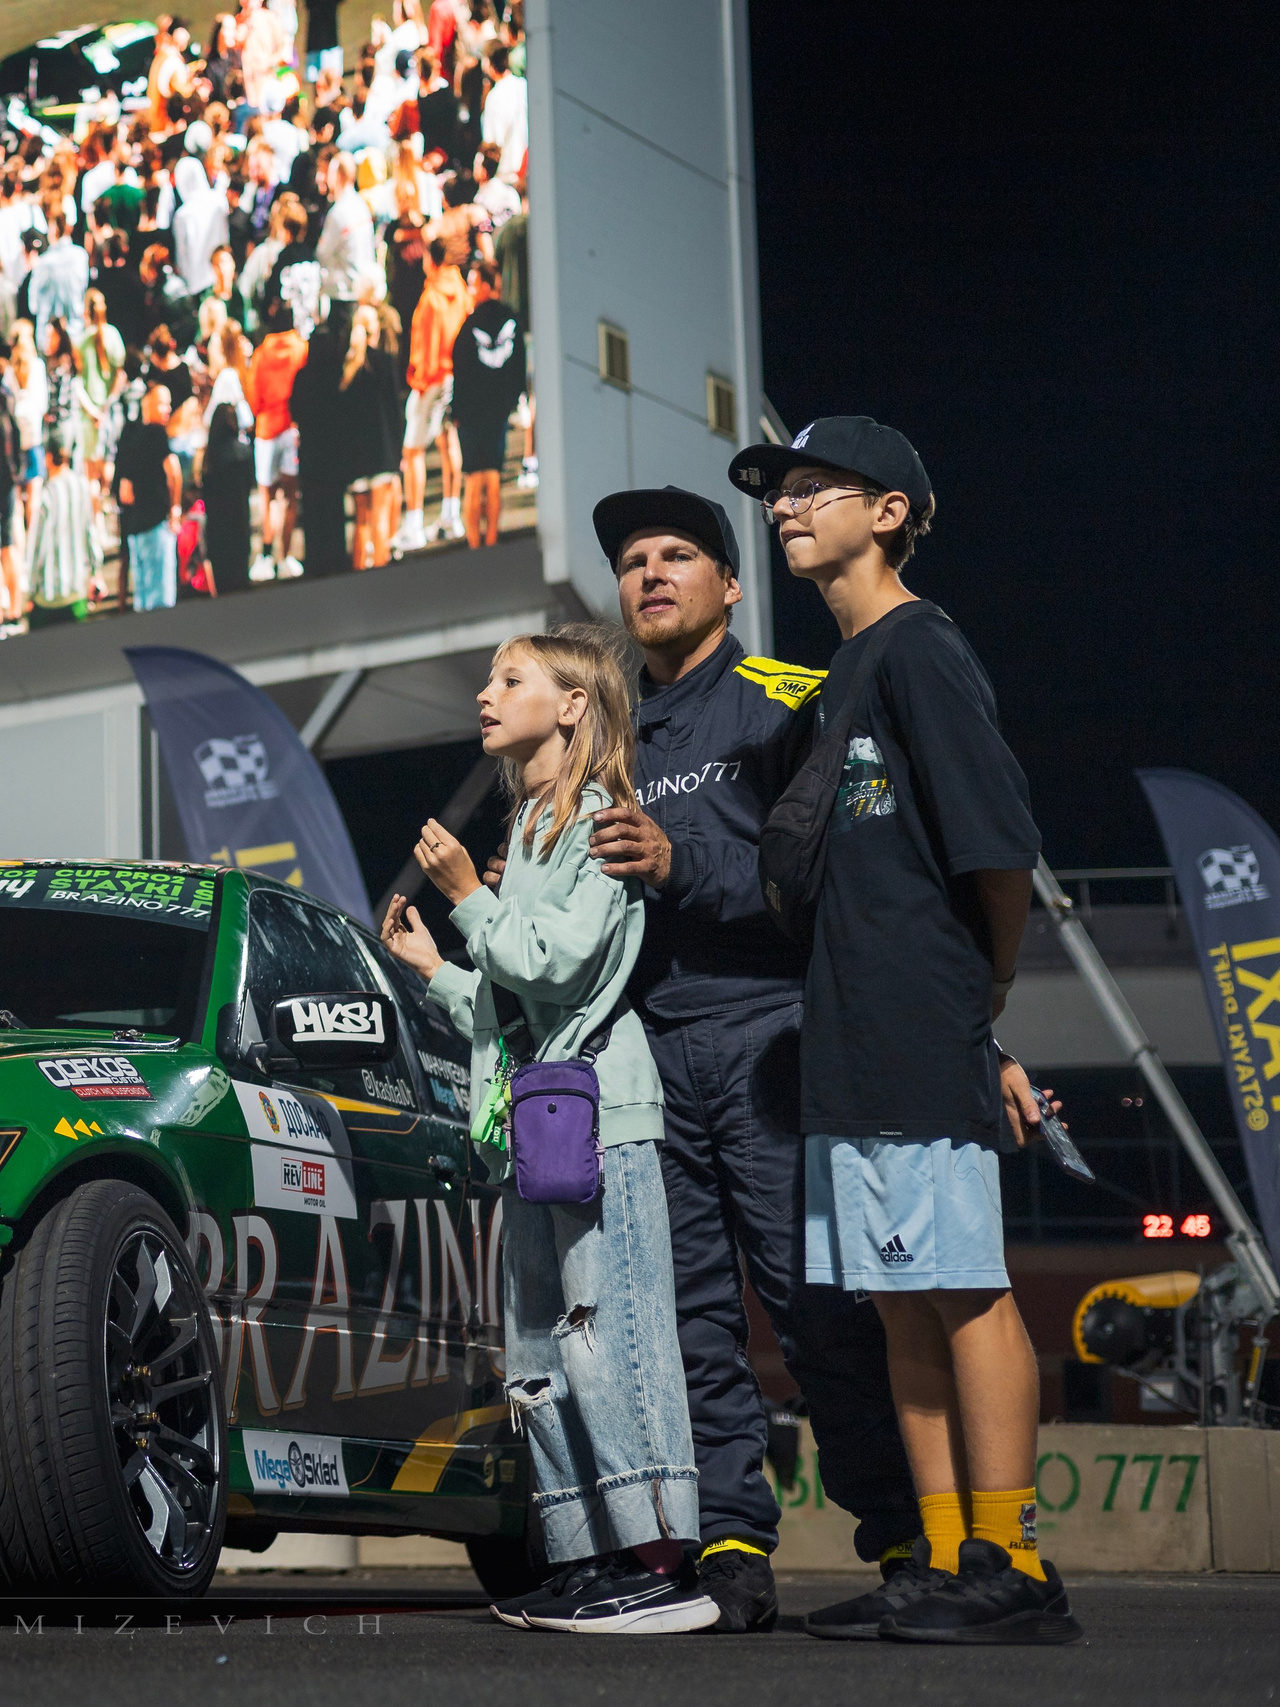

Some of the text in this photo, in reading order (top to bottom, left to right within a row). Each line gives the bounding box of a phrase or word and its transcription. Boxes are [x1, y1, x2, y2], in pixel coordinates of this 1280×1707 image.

[776, 682, 807, 694] OMP
[55, 869, 111, 879] CUP
[115, 870, 185, 884] PRO2
[48, 878, 183, 896] STAYKI
[50, 890, 163, 910] BRAZINO
[165, 904, 209, 918] 777
[111, 1076, 144, 1084] CUSTOM
[75, 1088, 101, 1096] CLUTCH
[112, 1087, 149, 1095] SUSPENSION
[278, 1098, 331, 1140] ДОСААФ
[1094, 1454, 1202, 1512] 777
